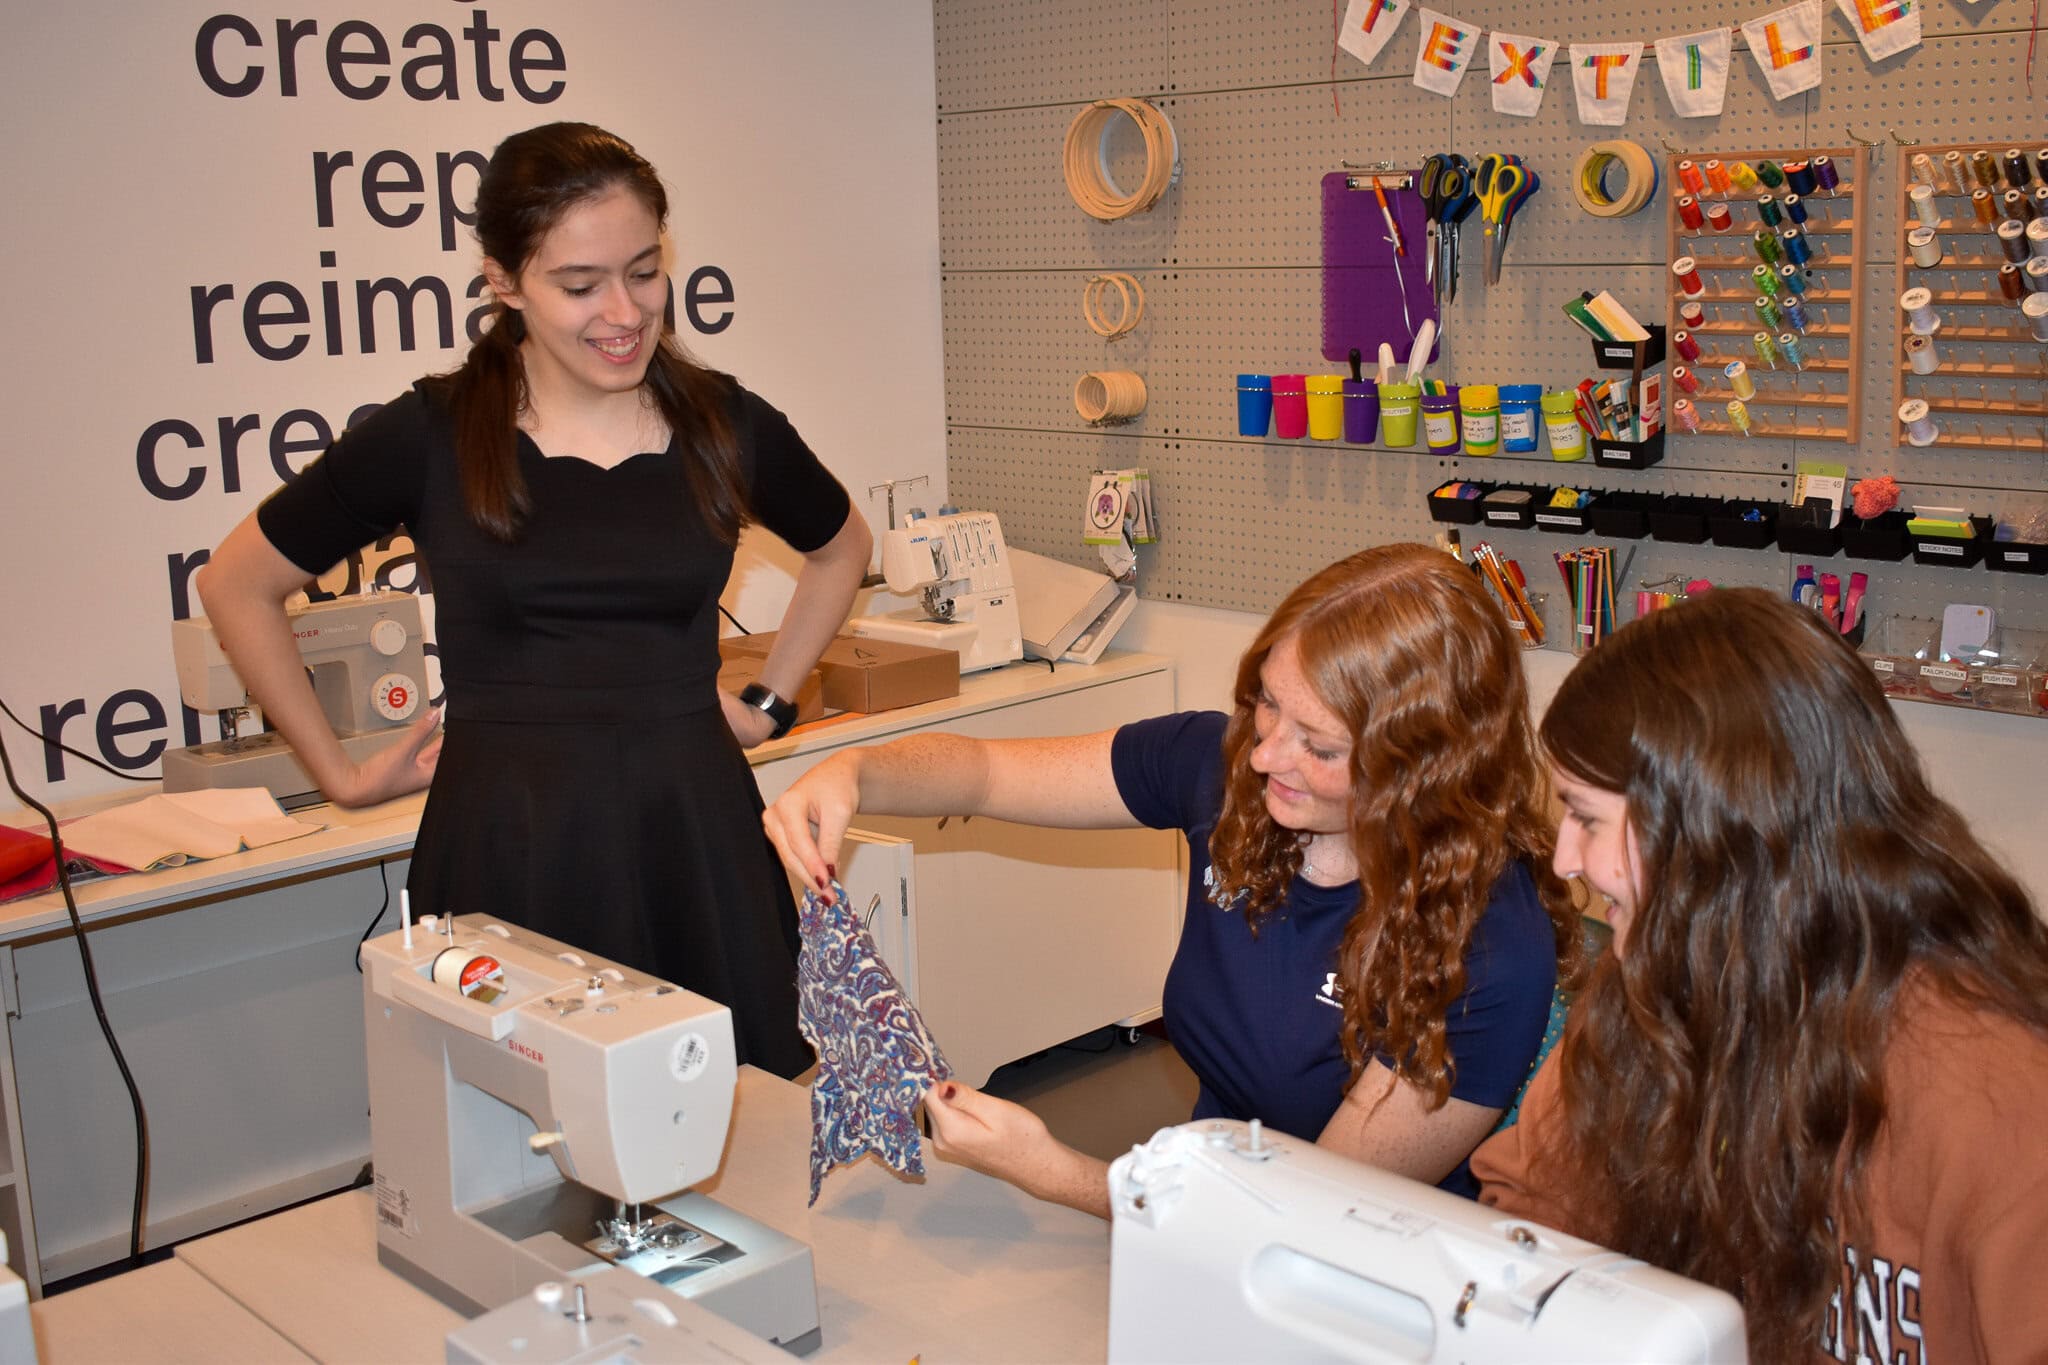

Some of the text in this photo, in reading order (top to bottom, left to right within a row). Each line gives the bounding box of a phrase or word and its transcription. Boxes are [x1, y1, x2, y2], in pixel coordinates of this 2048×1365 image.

[195, 9, 568, 104] create
[312, 150, 487, 251] rep
[190, 251, 735, 364] reimae
[137, 404, 392, 500] cre
[292, 629, 319, 639] NGER
[1875, 662, 1892, 670] CLIPS
[1922, 667, 1965, 679] TAILOR CHALK
[508, 1039, 544, 1063] SINGER
